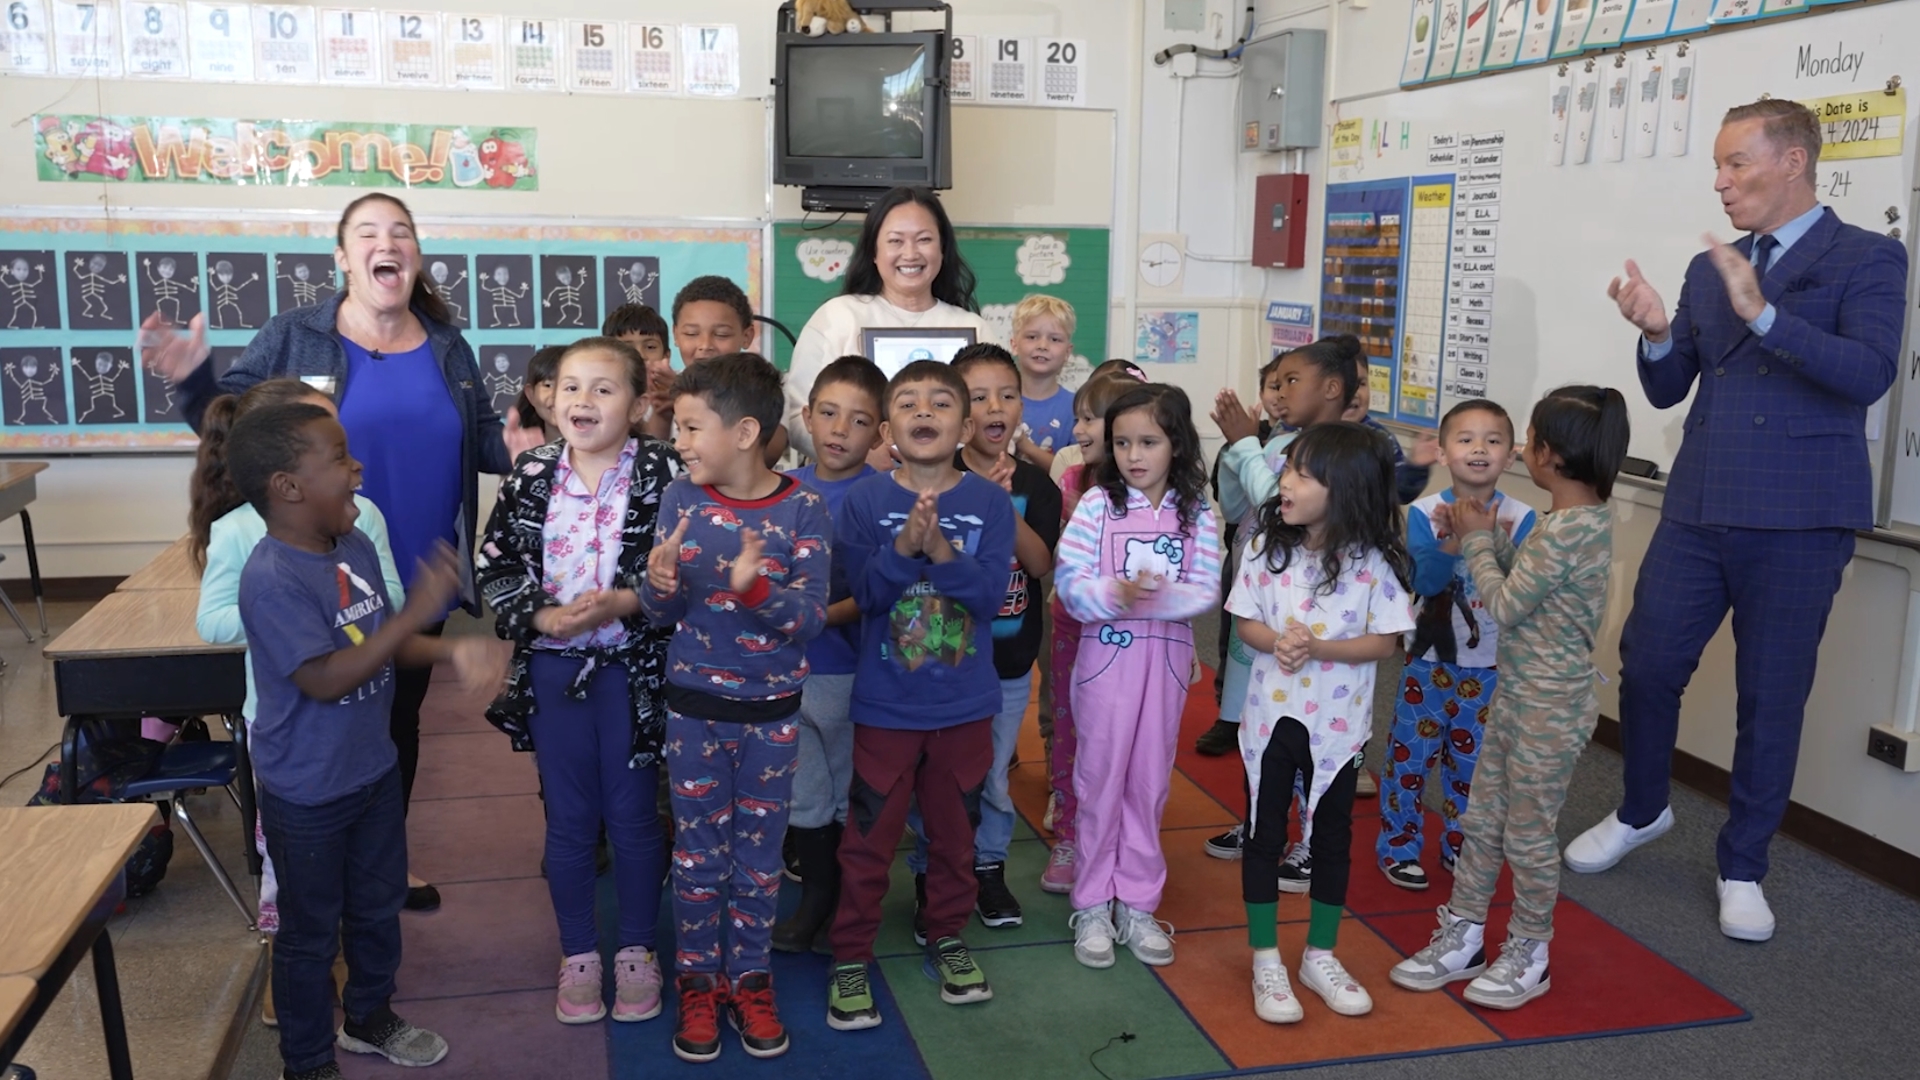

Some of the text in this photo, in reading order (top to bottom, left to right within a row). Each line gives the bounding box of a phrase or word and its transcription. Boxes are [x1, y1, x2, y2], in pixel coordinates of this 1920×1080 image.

[1602, 5, 1622, 14] gorilla
[7, 2, 29, 30] 6
[76, 4, 95, 32] 7
[144, 6, 163, 35] 8
[209, 9, 230, 37] 9
[269, 11, 298, 39] 10
[341, 13, 354, 36] 11
[400, 15, 422, 39] 12
[461, 18, 484, 41] 13
[522, 21, 544, 44] 14
[583, 24, 605, 47] 15
[642, 26, 663, 49] 16
[700, 28, 720, 51] 17
[952, 38, 964, 59] 8
[998, 38, 1018, 61] 19
[1047, 42, 1076, 64] 20
[13, 55, 32, 66] six
[70, 57, 109, 69] seven
[141, 59, 172, 72] eight
[1795, 41, 1864, 82] Monday
[209, 62, 234, 73] nine
[276, 64, 297, 74] ten
[334, 69, 366, 77] eleven
[398, 71, 429, 80] twelve
[456, 74, 493, 82] thirteen
[515, 76, 556, 85] fourteen
[579, 79, 611, 88] fifteen
[638, 80, 669, 89] sixteen
[689, 82, 736, 92] seventeen
[990, 91, 1025, 99] nineteen
[1047, 93, 1074, 102] twenty
[1826, 102, 1852, 116] Date
[1858, 99, 1869, 112] is
[1841, 116, 1880, 143] 2024
[1434, 135, 1453, 146] Today's
[1471, 135, 1504, 146] Penmanship
[131, 121, 453, 184] Welcome!
[1430, 153, 1454, 163] Schedule
[1474, 155, 1499, 164] Calendar
[1418, 191, 1446, 202] Weather
[1472, 190, 1497, 200] Journals
[1472, 228, 1490, 236] Recess
[805, 245, 847, 255] Use counters
[1029, 250, 1054, 261] picture
[1480, 263, 1494, 271] cont.
[1470, 281, 1485, 289] Lunch
[1469, 299, 1483, 307] Math
[1269, 305, 1303, 321] JANUARY
[1466, 316, 1484, 325] Recess
[1273, 327, 1307, 343] FEBRUARY
[1459, 334, 1474, 344] Story
[1475, 334, 1488, 343] Time
[1464, 351, 1482, 362] Writing
[1374, 368, 1389, 378] School
[1460, 368, 1484, 379] Clean Up
[1457, 384, 1485, 397] Dismissal
